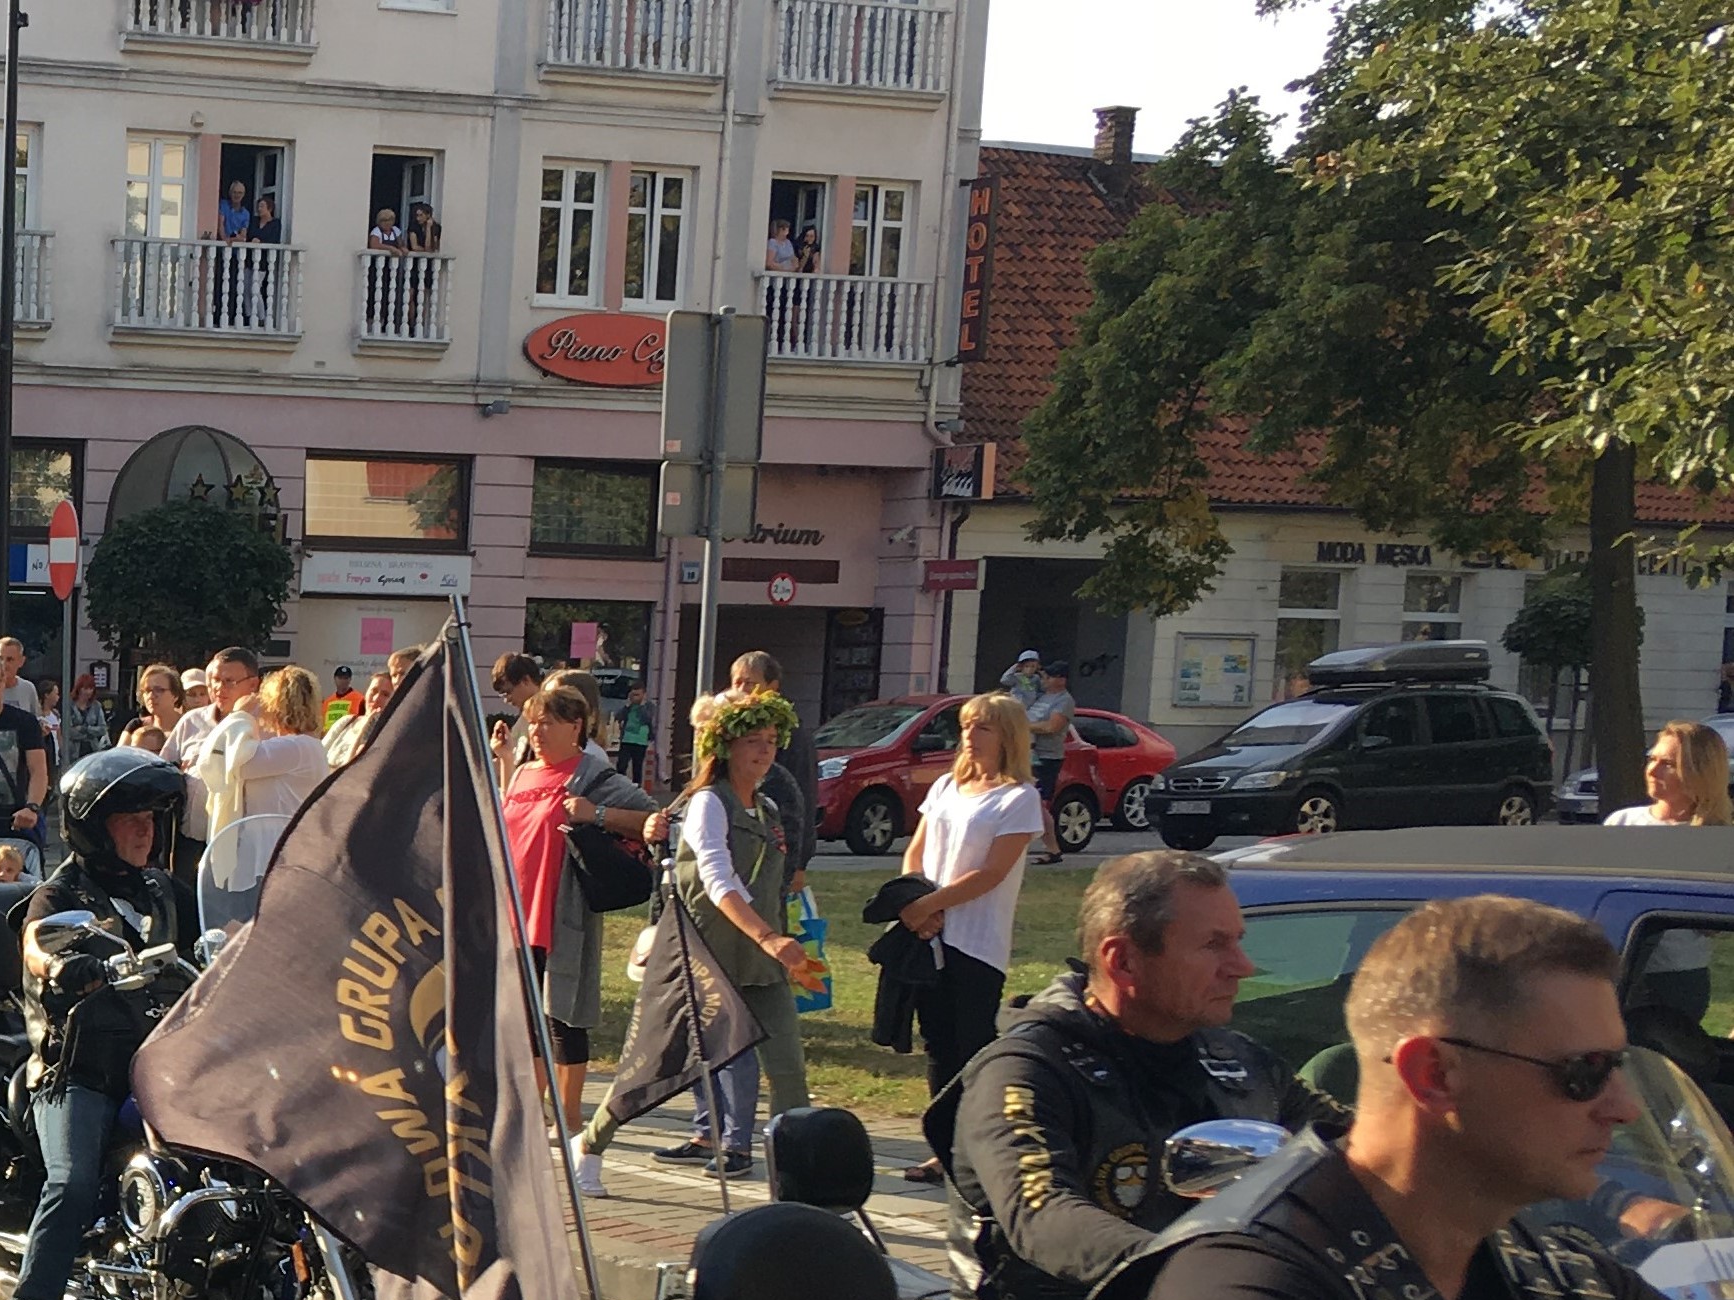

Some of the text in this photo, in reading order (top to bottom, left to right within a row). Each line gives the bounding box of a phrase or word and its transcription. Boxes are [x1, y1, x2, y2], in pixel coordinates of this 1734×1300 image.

[958, 186, 991, 351] HOTEL
[542, 328, 627, 361] Piano
[1317, 541, 1365, 563] MODA
[1376, 543, 1432, 567] MĘSKA
[337, 898, 441, 1051] GRUPA
